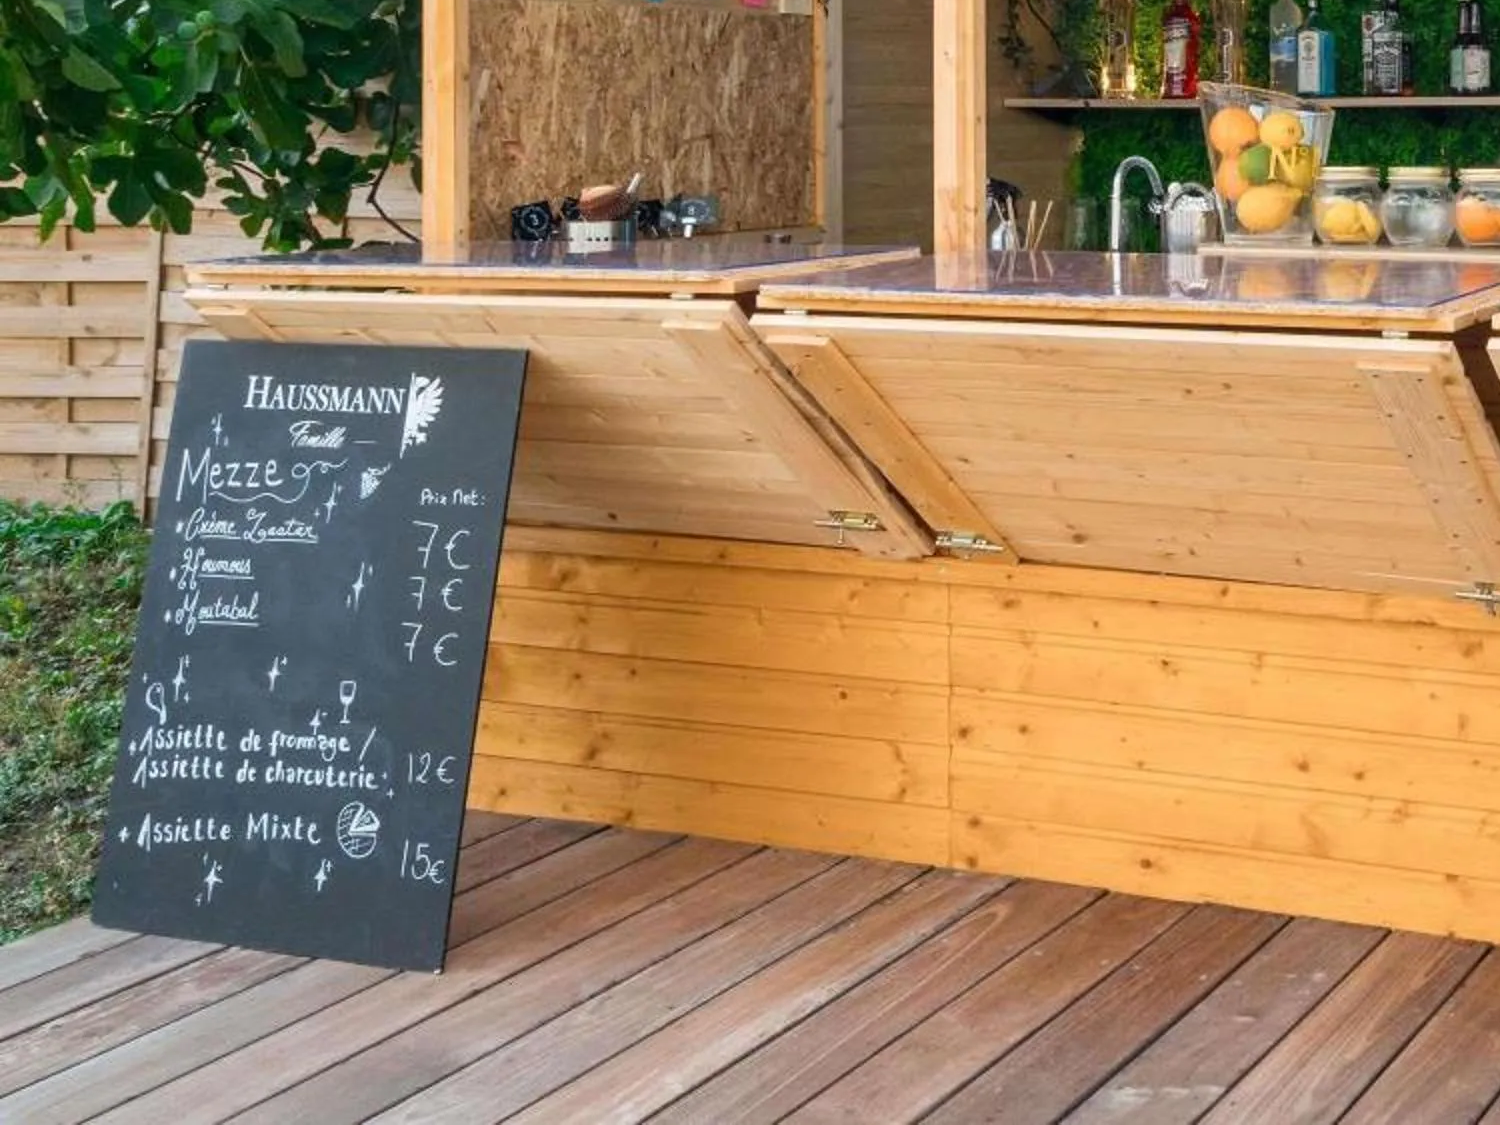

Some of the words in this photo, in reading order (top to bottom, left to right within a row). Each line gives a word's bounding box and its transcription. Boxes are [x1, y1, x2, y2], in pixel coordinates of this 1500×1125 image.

[243, 375, 405, 414] HAUSSMANN
[289, 420, 347, 449] Famille
[176, 447, 283, 504] Mezze
[420, 488, 447, 506] Prix
[139, 725, 228, 757] Assiette
[239, 728, 262, 752] de
[269, 729, 350, 762] fromage
[132, 756, 224, 788] Assiette
[236, 759, 256, 783] de
[265, 760, 379, 789] charcuterie
[137, 813, 231, 851] Assiette
[247, 812, 321, 844] Mixte
